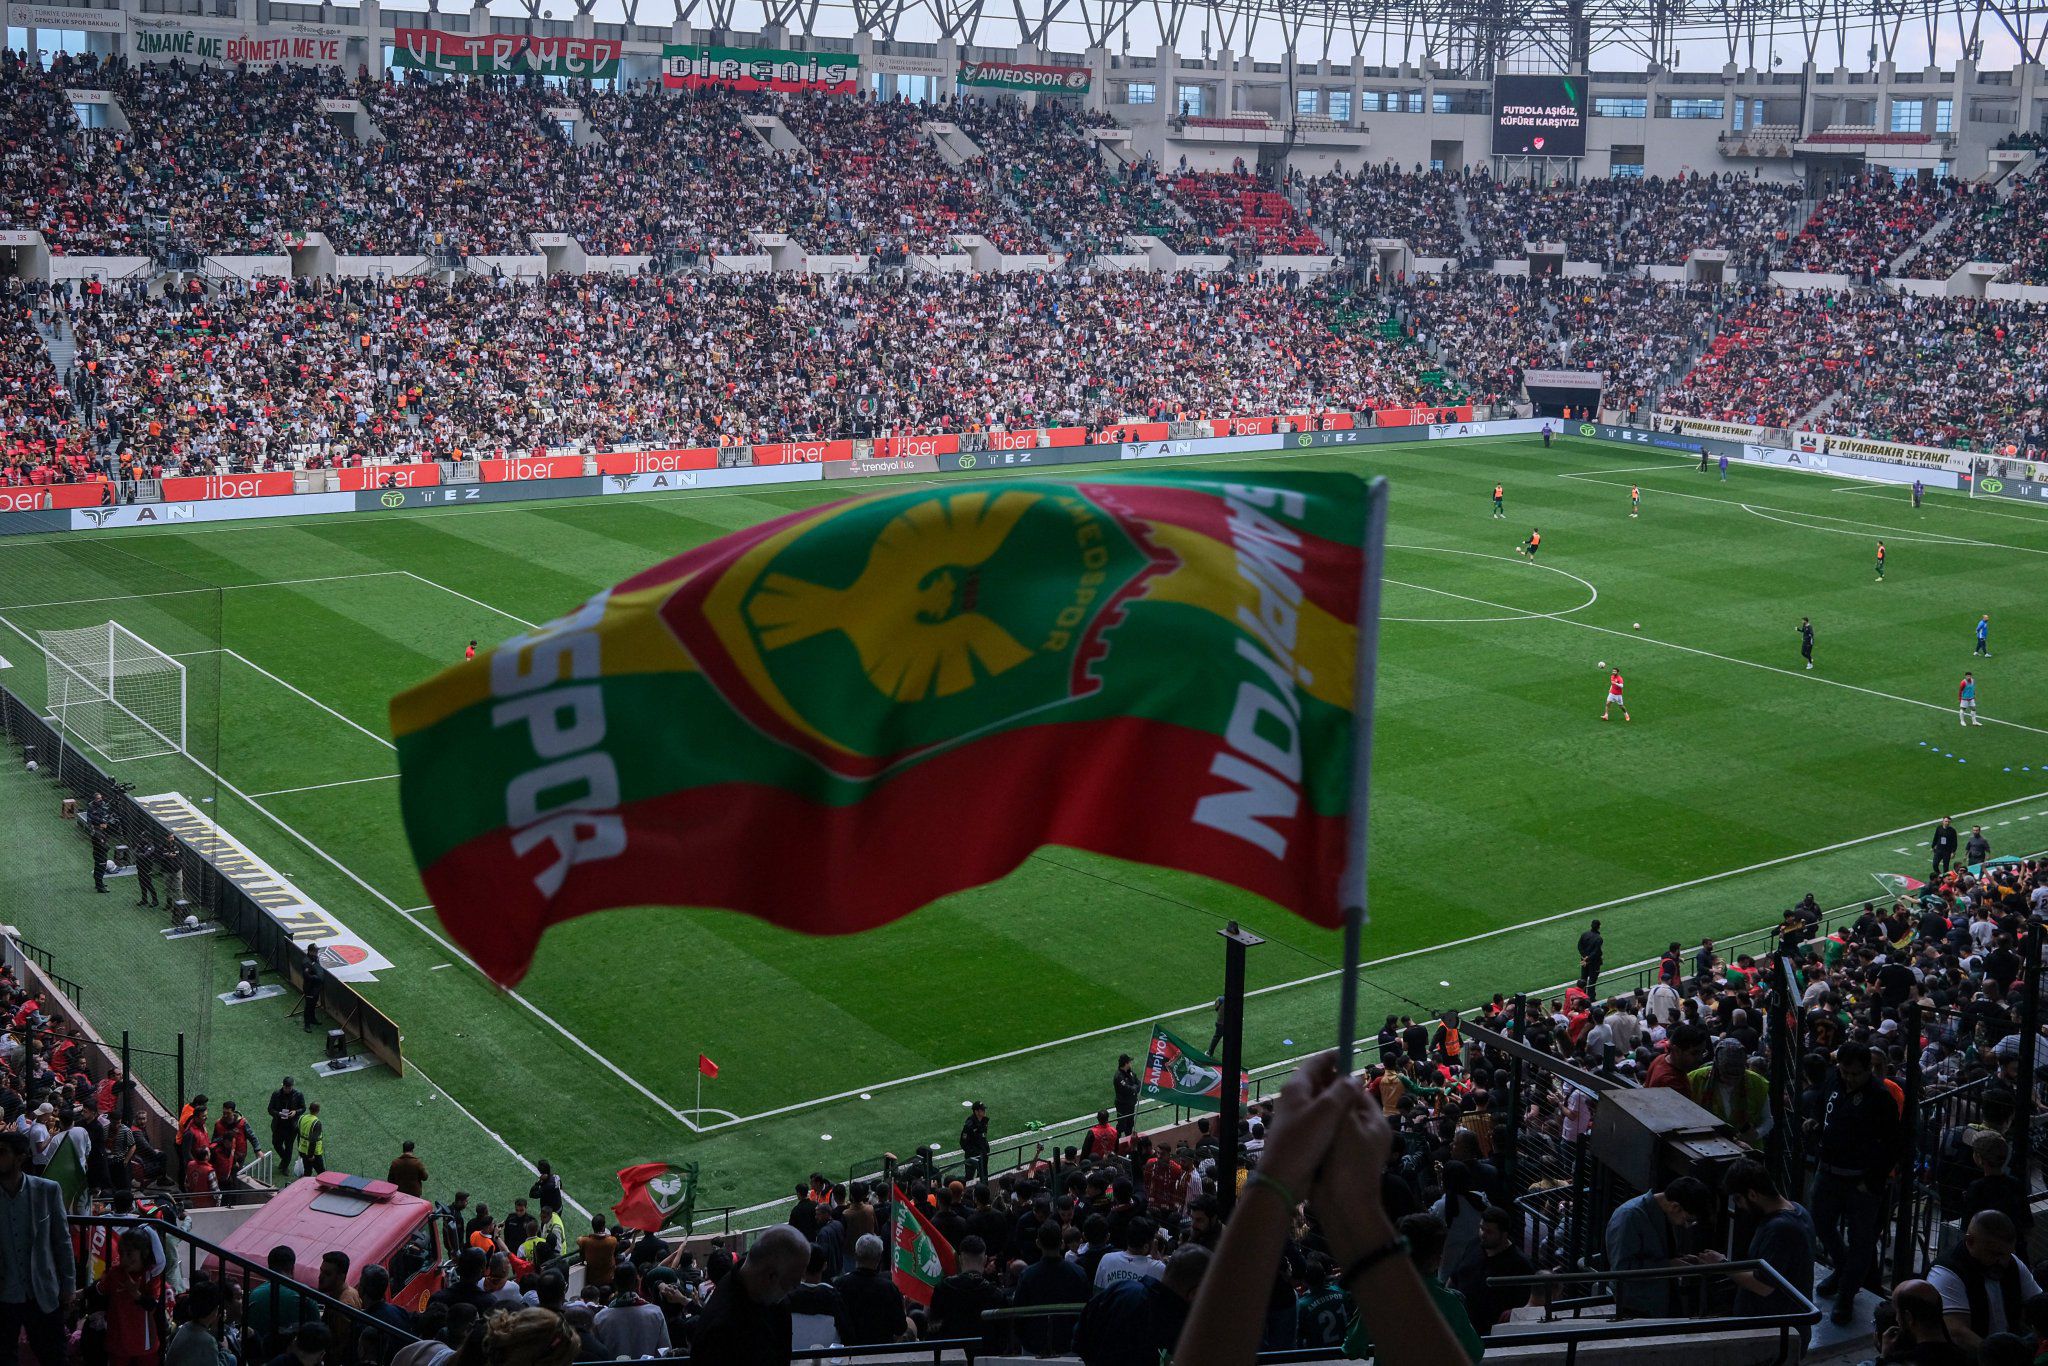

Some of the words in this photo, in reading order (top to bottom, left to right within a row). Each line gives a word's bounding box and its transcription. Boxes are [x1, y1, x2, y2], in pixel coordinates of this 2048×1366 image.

[198, 37, 222, 58] ME
[293, 38, 314, 59] ME
[319, 40, 340, 60] YE
[978, 67, 1064, 86] AMEDSPOR
[1500, 116, 1534, 126] KÜFÜRE
[1503, 106, 1544, 115] FUTBOLA
[1544, 105, 1578, 117] AŞIĞIZ,
[861, 400, 873, 411] 21
[1409, 408, 1435, 425] jibe
[1664, 416, 1674, 426] ÖZ
[1676, 418, 1720, 432] İYARBAKIR
[1722, 426, 1752, 436] SEYAHAT
[780, 444, 824, 464] jiber
[1839, 440, 1904, 458] DİYARBAKIR
[1906, 449, 1951, 464] SEYAHAT
[503, 460, 554, 482] jiber
[632, 452, 680, 474] jiber
[862, 460, 898, 472] trendyol
[202, 476, 262, 500] jiber
[360, 467, 416, 490] jiber
[0, 492, 42, 510] ber
[1148, 1031, 1168, 1094] ŞAMPİYON
[1824, 1091, 1838, 1126] POL
[1107, 1271, 1145, 1283] AMEDSPO
